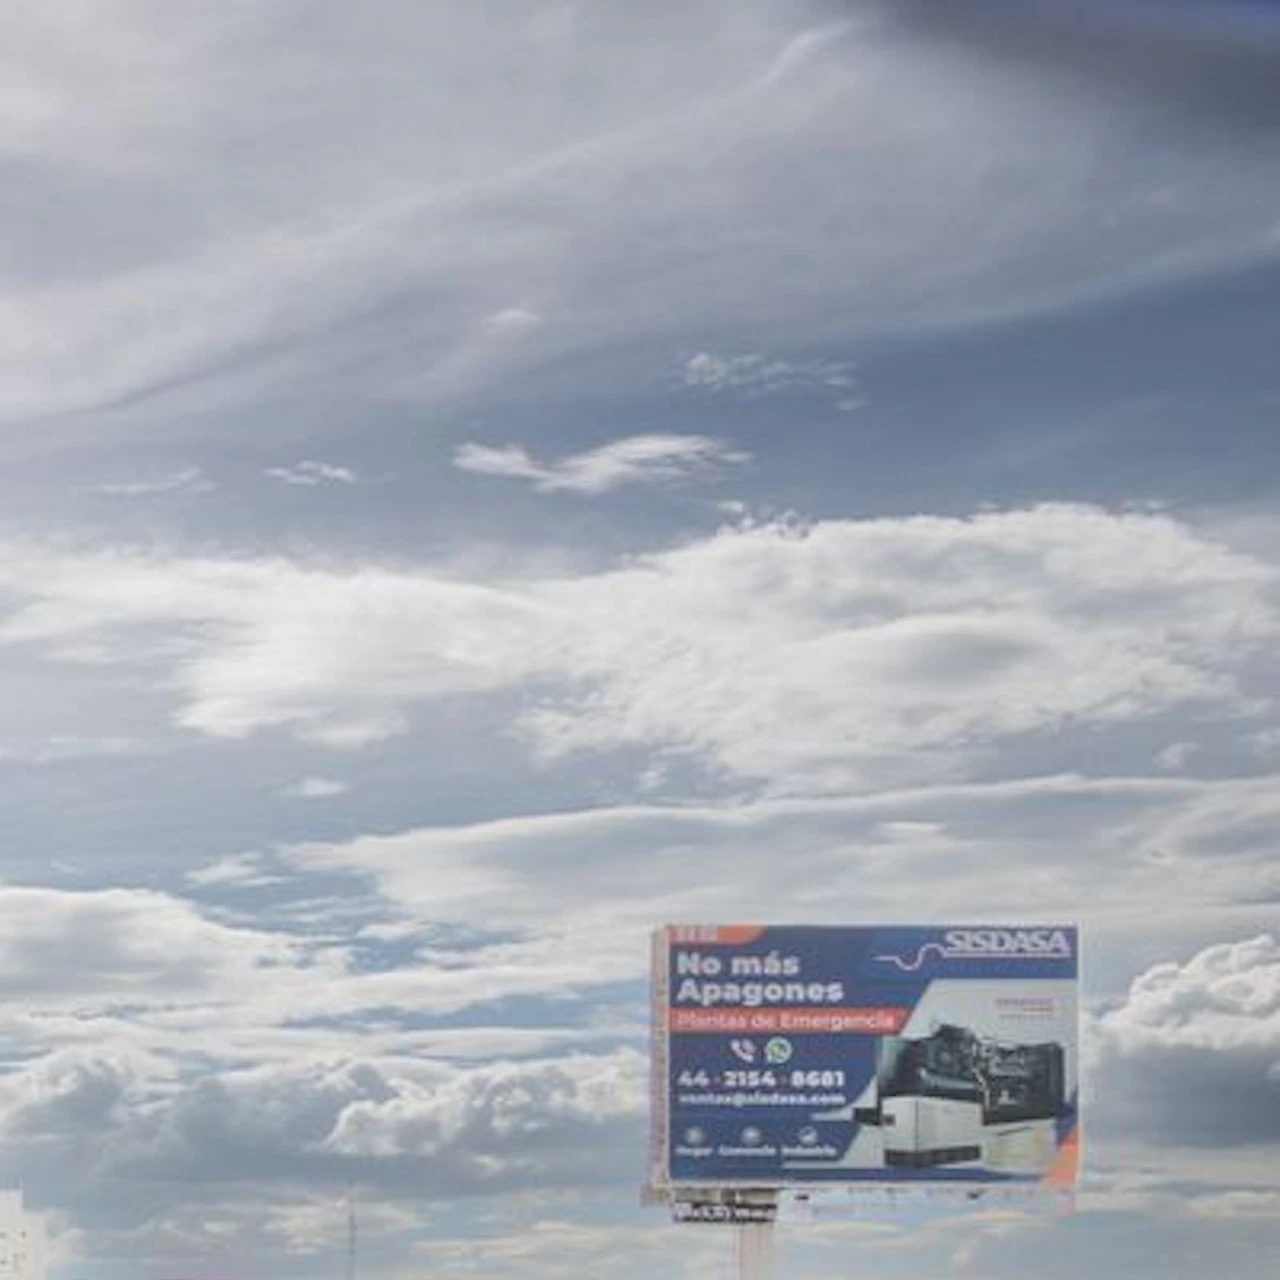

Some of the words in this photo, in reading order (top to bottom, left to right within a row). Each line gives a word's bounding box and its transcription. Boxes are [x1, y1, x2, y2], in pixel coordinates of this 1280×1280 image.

[945, 930, 1072, 953] SISDASA
[677, 953, 721, 975] No
[731, 951, 801, 975] más
[677, 978, 844, 1006] Apagones
[677, 1010, 747, 1028] Plantas
[751, 1010, 773, 1028] de
[779, 1010, 896, 1031] Emergencia
[678, 1071, 710, 1087] 44
